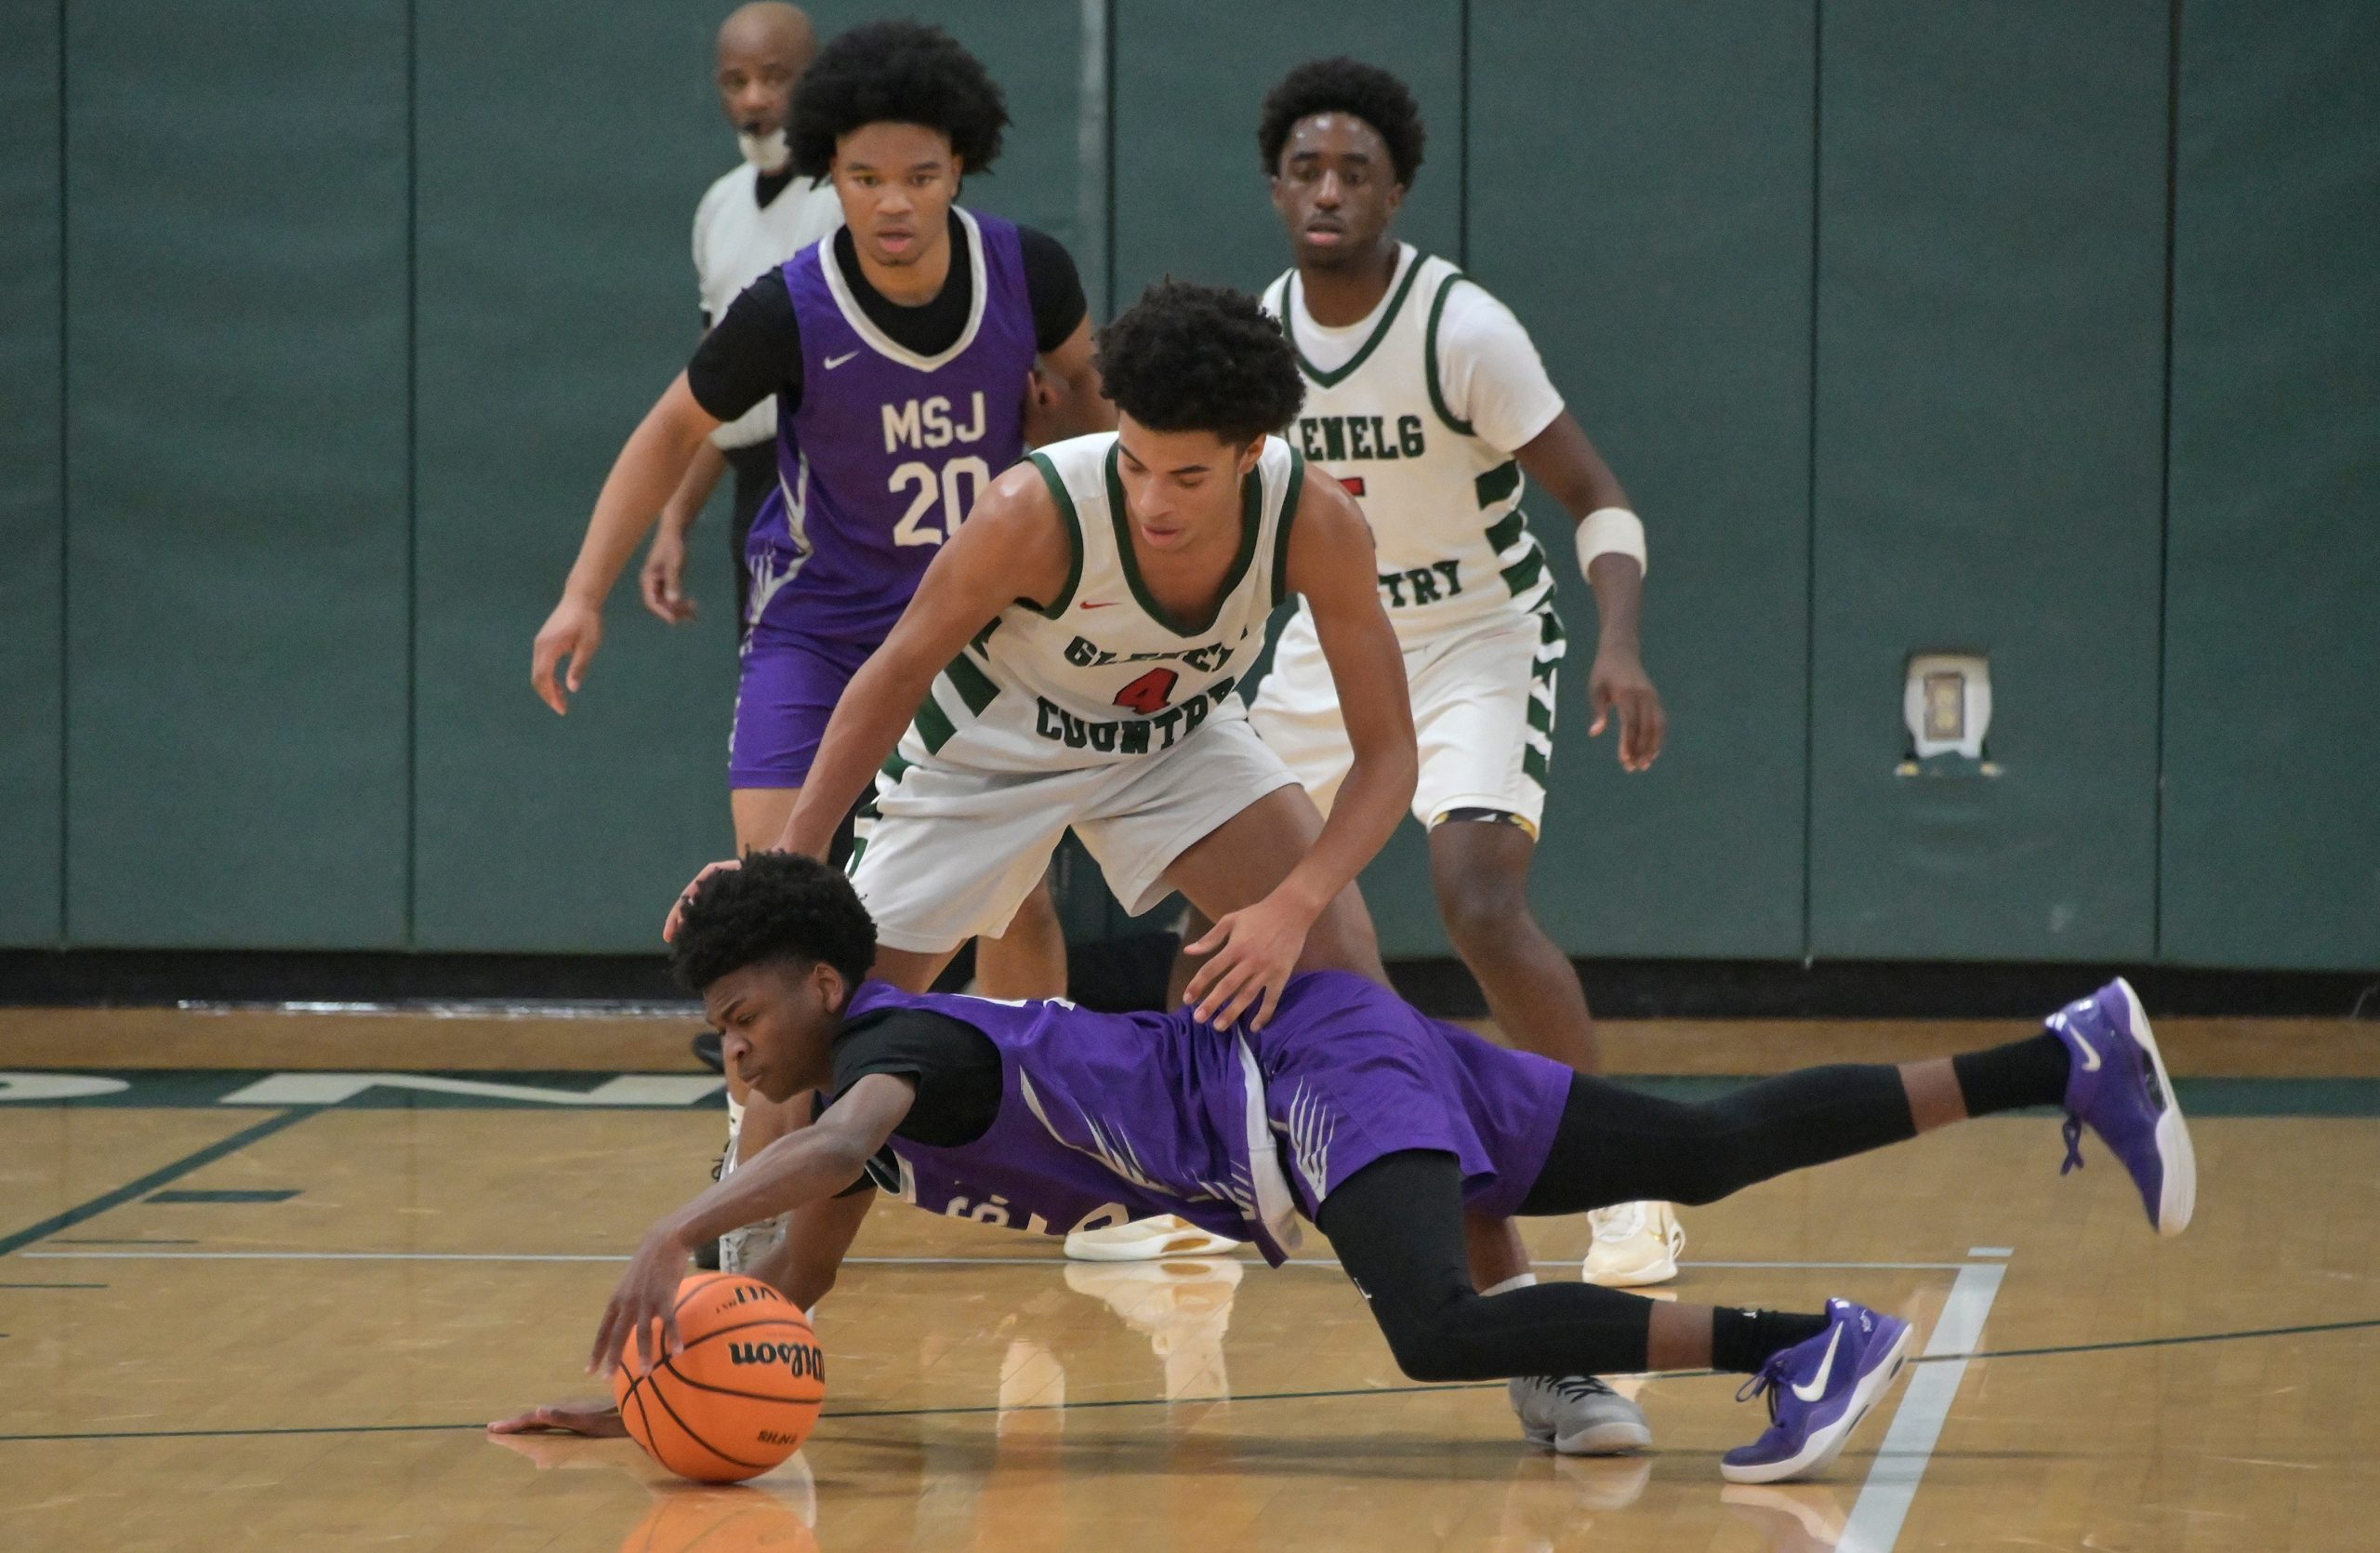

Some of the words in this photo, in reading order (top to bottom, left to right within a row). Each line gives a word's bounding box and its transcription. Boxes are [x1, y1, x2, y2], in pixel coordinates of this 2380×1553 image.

[881, 391, 986, 454] MSJ
[1285, 415, 1425, 461] ENELG
[888, 456, 991, 547] 20
[1377, 560, 1461, 607] TRY
[1112, 667, 1179, 715] 4
